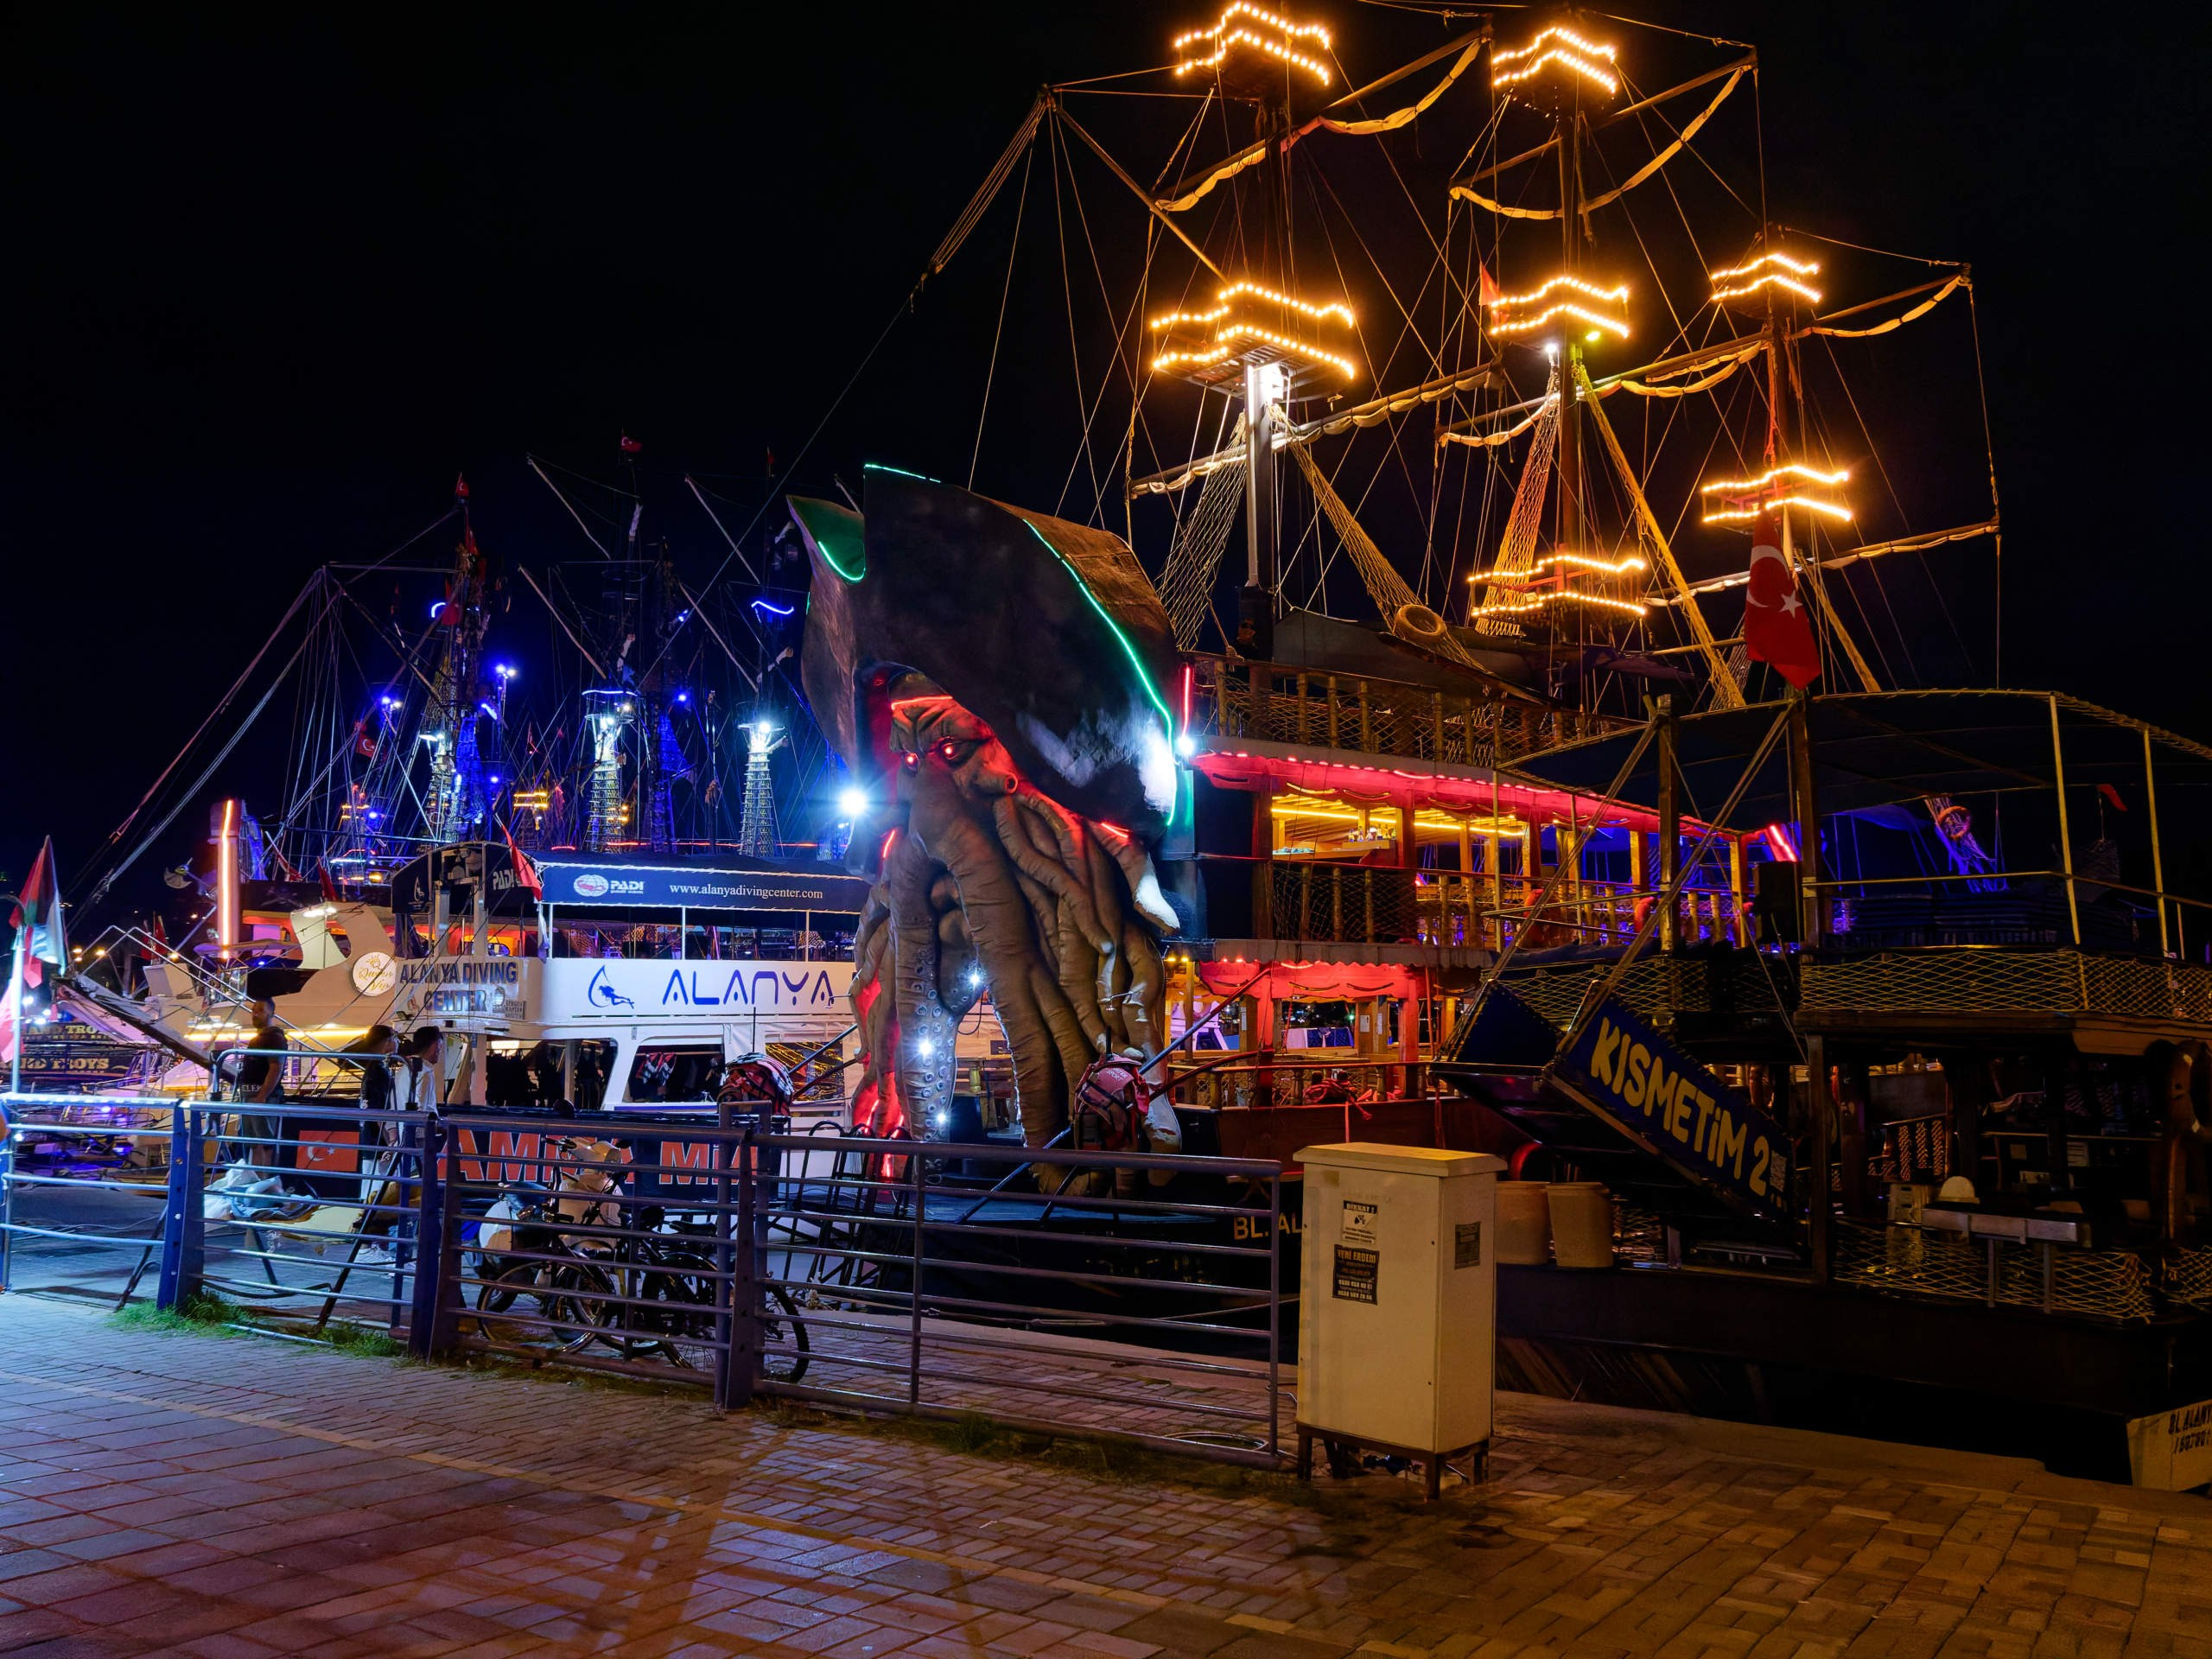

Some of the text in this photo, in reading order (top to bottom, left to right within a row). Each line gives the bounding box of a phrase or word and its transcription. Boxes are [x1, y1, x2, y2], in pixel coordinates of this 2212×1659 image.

[493, 868, 515, 891] PADI
[610, 880, 644, 891] PADI
[670, 883, 823, 899] www.alanyadivingcenter.com
[400, 962, 518, 983] ALANYA DIVING
[663, 969, 835, 1005] ALANYA
[423, 989, 486, 1012] CENTER
[1749, 1135, 1770, 1197] 2
